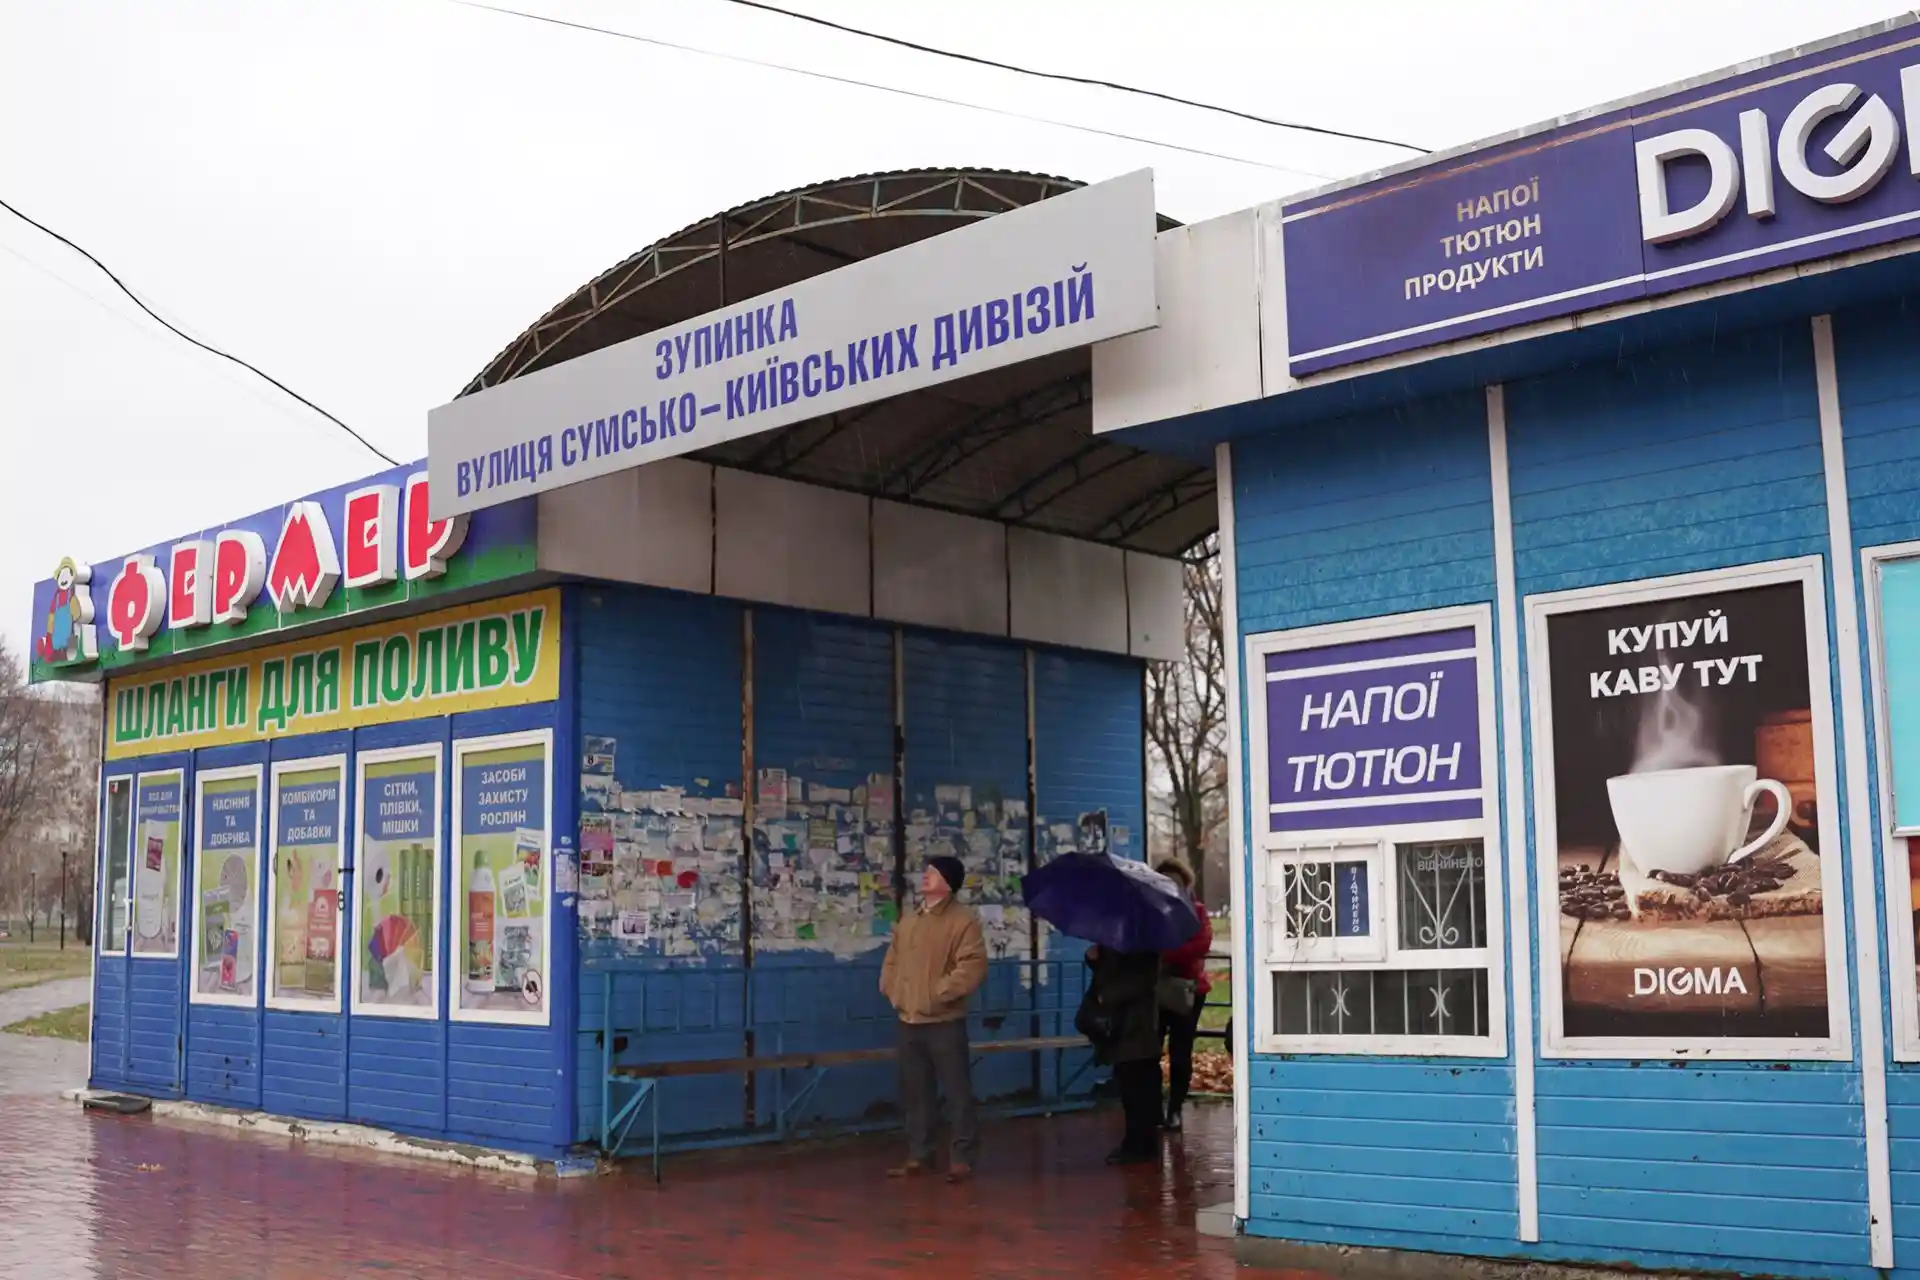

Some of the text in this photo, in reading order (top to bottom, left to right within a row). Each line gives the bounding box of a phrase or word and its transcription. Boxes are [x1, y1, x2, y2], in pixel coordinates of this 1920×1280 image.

[1635, 64, 1920, 245] DIG
[1456, 175, 1539, 222] НАПОЇ
[1440, 213, 1541, 258] ТЮТЮН
[1405, 245, 1543, 300] ПРОДУКТИ
[655, 298, 798, 380] ЗУПИНКА
[457, 433, 553, 498] ВУЛИЦЯ
[932, 262, 1096, 371] ДИВІЗІЙ
[1608, 609, 1728, 655] КУПУЙ
[115, 607, 545, 743] ШЛАНГИ ДЛЯ ПОЛИВУ
[1590, 654, 1763, 698] КАВУ ТУТ
[1300, 671, 1444, 731] НАПОЇ
[481, 768, 526, 784] ЗАСОБИ
[1287, 742, 1461, 793] ТЮТЮН
[282, 788, 336, 805] КОМБІКОРМ
[384, 780, 418, 796] СІТКИ,
[479, 788, 528, 805] ЗАХИСТУ
[212, 796, 250, 811] НАСІННЯ
[380, 801, 422, 816] ПЛІВКИ,
[225, 815, 236, 827] ТА
[304, 809, 316, 821] ТА
[480, 810, 526, 826] РОСЛИН
[287, 826, 332, 842] ДОБАВКИ
[382, 819, 418, 834] МІШКИ
[210, 831, 250, 846] ДОБРИВА
[1634, 967, 1748, 995] DIGMA
